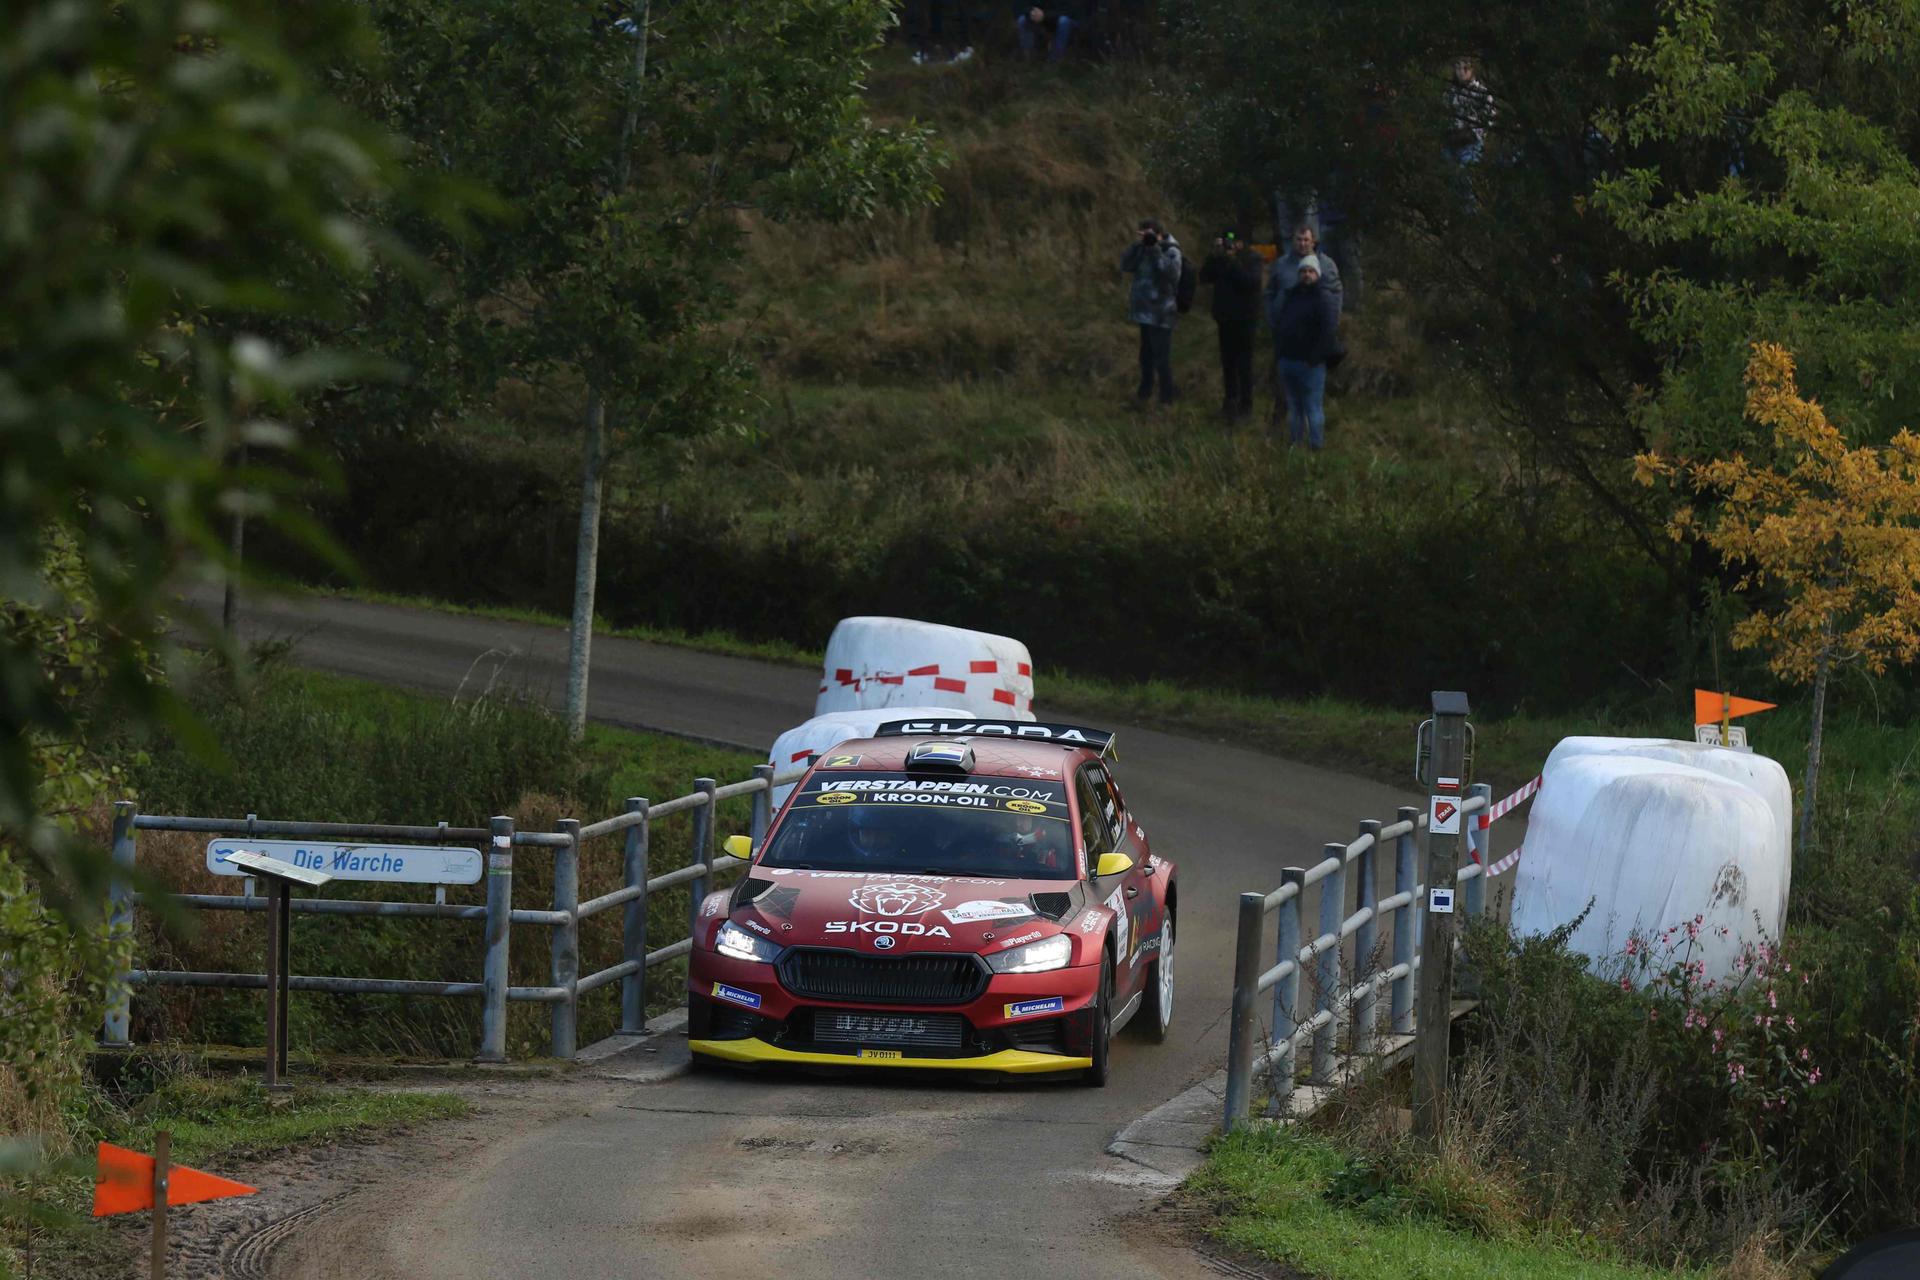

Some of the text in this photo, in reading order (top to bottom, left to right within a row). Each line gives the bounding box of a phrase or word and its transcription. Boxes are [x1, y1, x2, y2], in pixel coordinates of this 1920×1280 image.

[830, 754, 854, 766] 2
[820, 779, 1053, 802] VERSTAPPEN.COM
[873, 793, 989, 807] KROON-OIL
[293, 849, 324, 870] Die
[333, 851, 404, 873] Warche
[726, 990, 756, 1004] MICHELIN
[1021, 1002, 1056, 1012] MICHELIN
